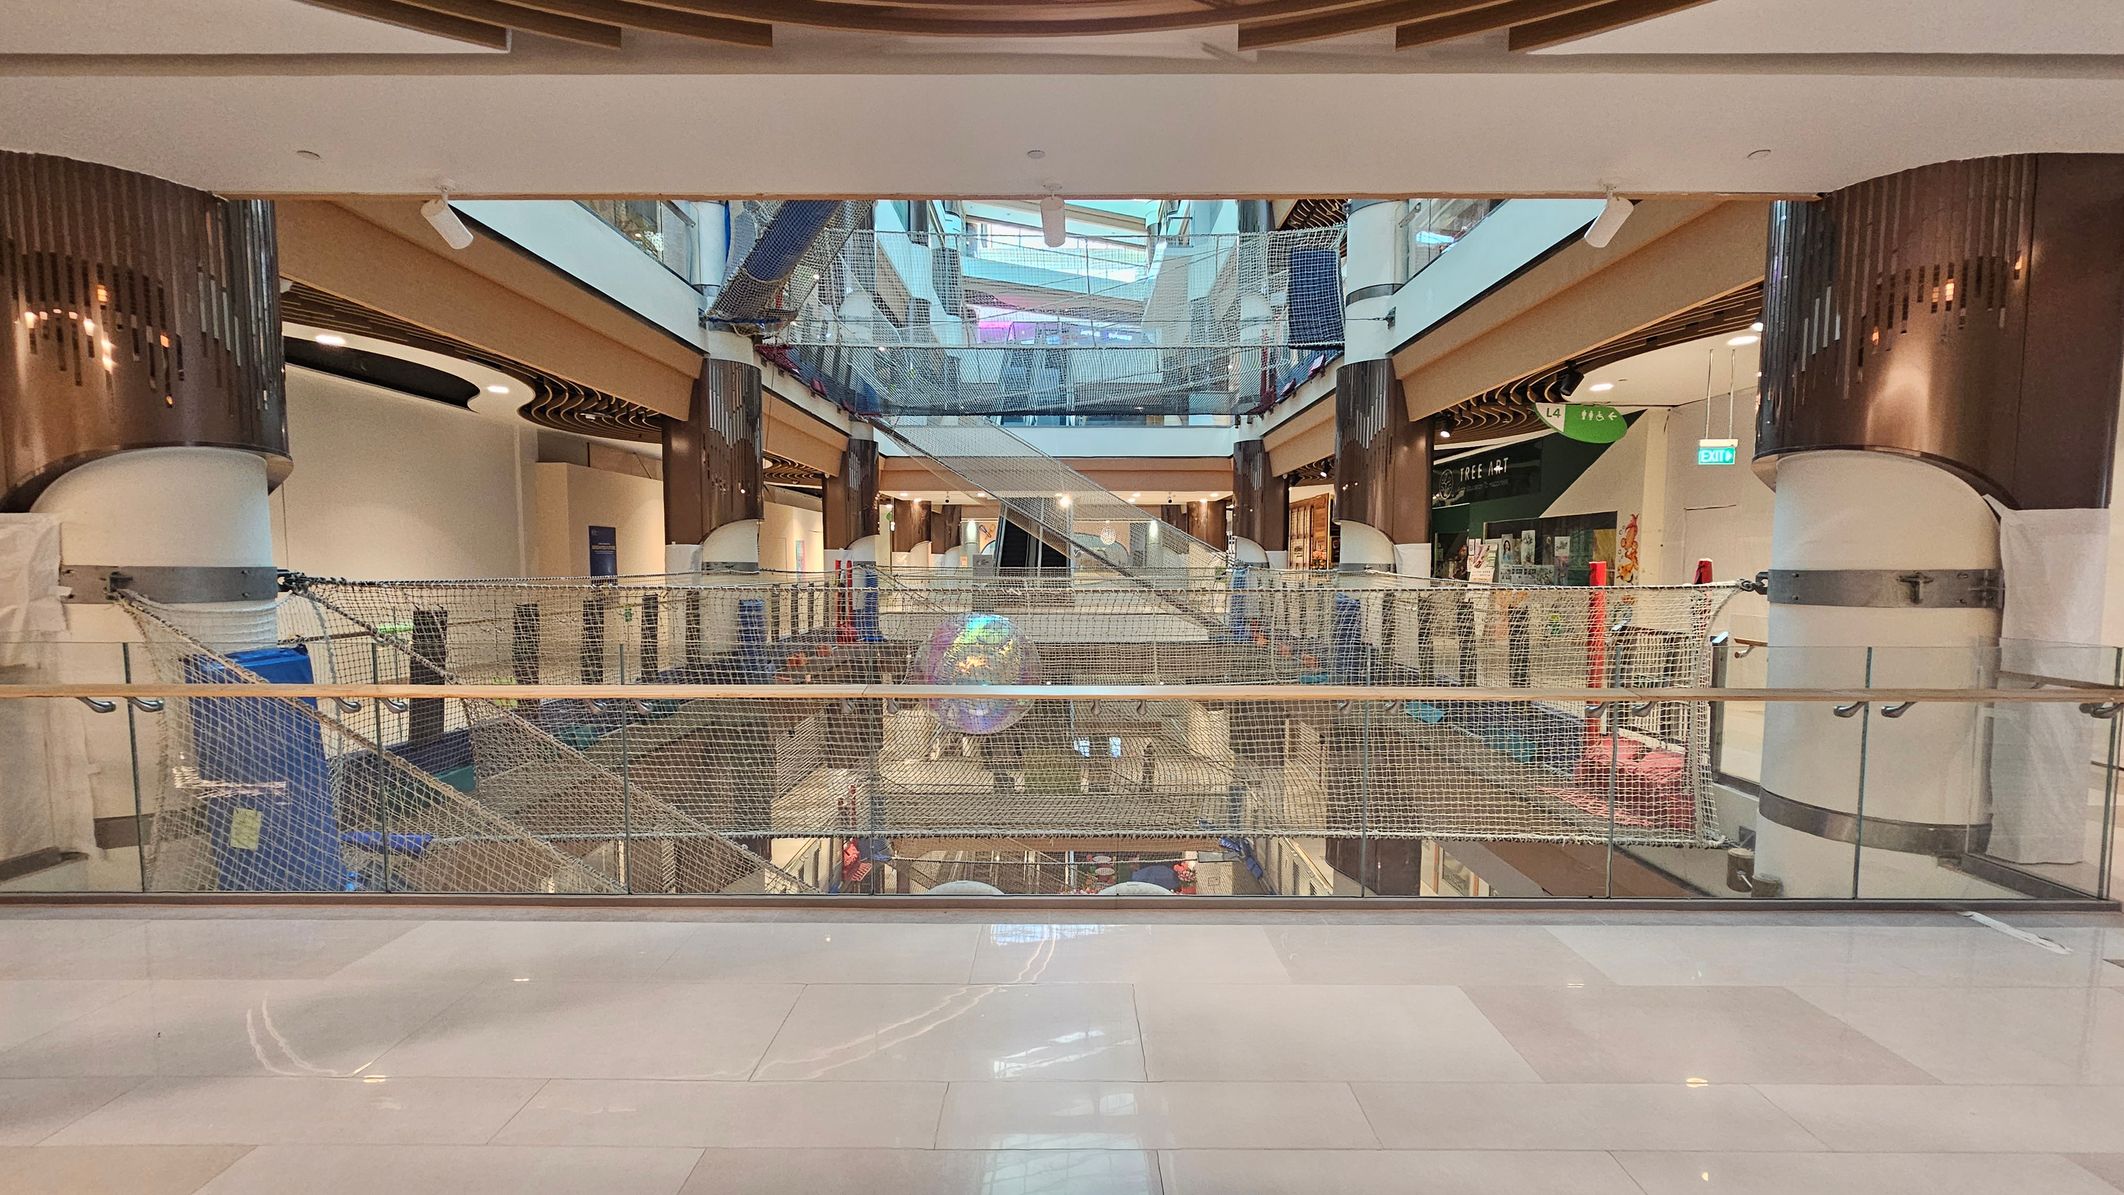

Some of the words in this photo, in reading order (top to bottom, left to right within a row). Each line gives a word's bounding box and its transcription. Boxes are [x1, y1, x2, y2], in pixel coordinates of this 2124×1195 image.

[1546, 407, 1561, 418] L4
[1700, 449, 1724, 462] EXIT
[1460, 463, 1483, 481] TREE
[1487, 457, 1509, 476] ART
